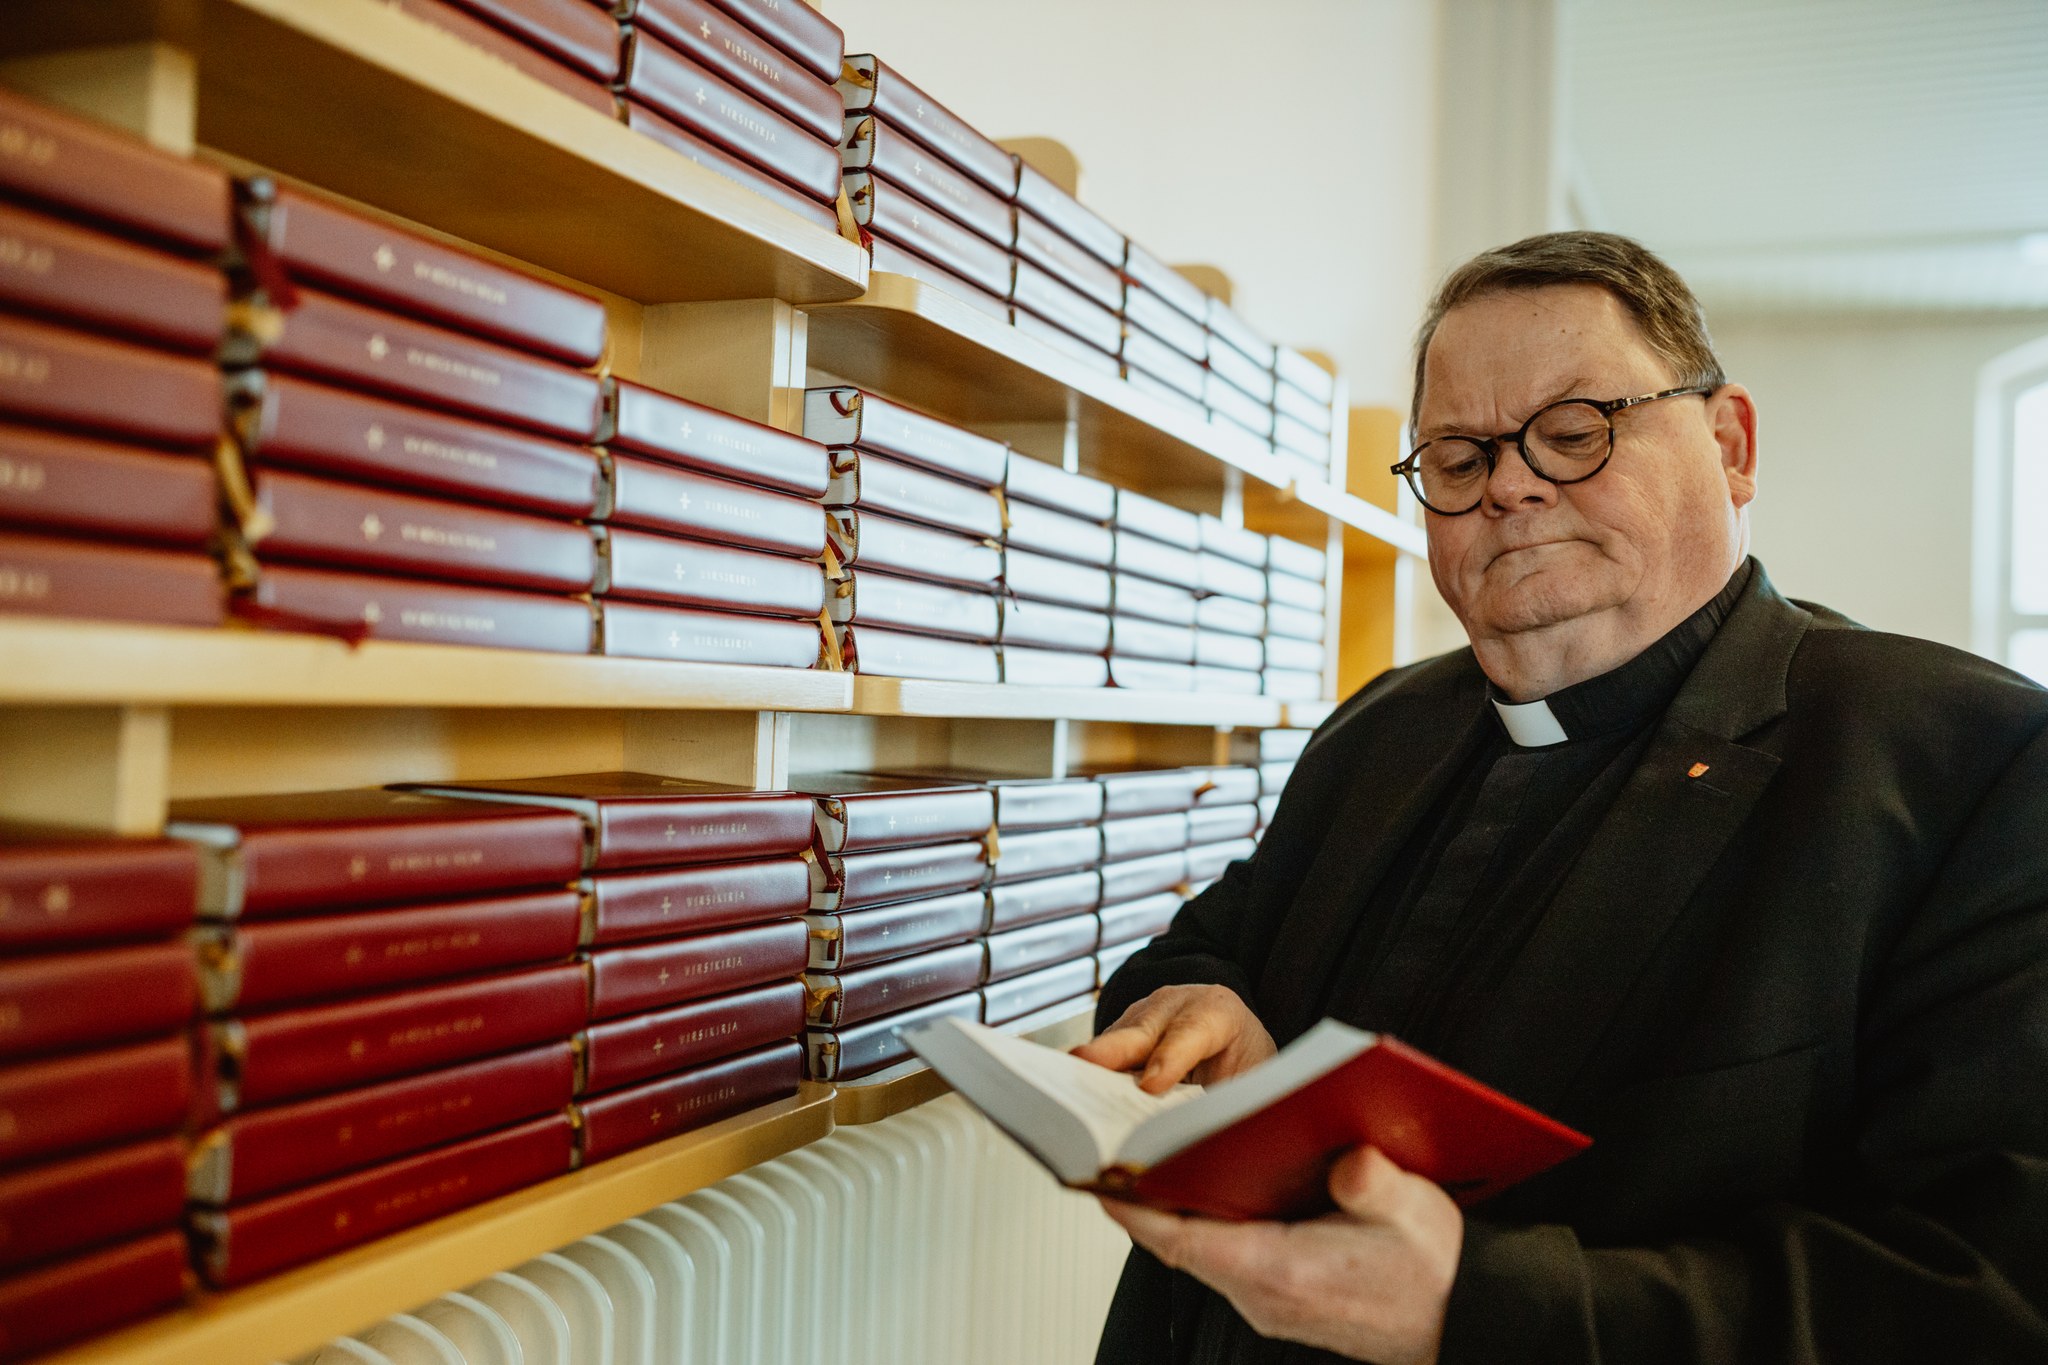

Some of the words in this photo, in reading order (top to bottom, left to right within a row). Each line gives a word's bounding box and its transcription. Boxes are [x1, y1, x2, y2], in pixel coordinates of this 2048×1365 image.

[724, 37, 780, 82] VIRSIKIRJA
[720, 102, 777, 143] VIRSIKIRJA
[689, 822, 748, 836] VIRSIKIRJA
[686, 890, 746, 908] VIRSIKIRJA
[684, 956, 743, 977] VIRSIKIRJA
[678, 1020, 738, 1045] VIRSIKIRJA
[676, 1085, 736, 1114] VIRSIKIRJA
